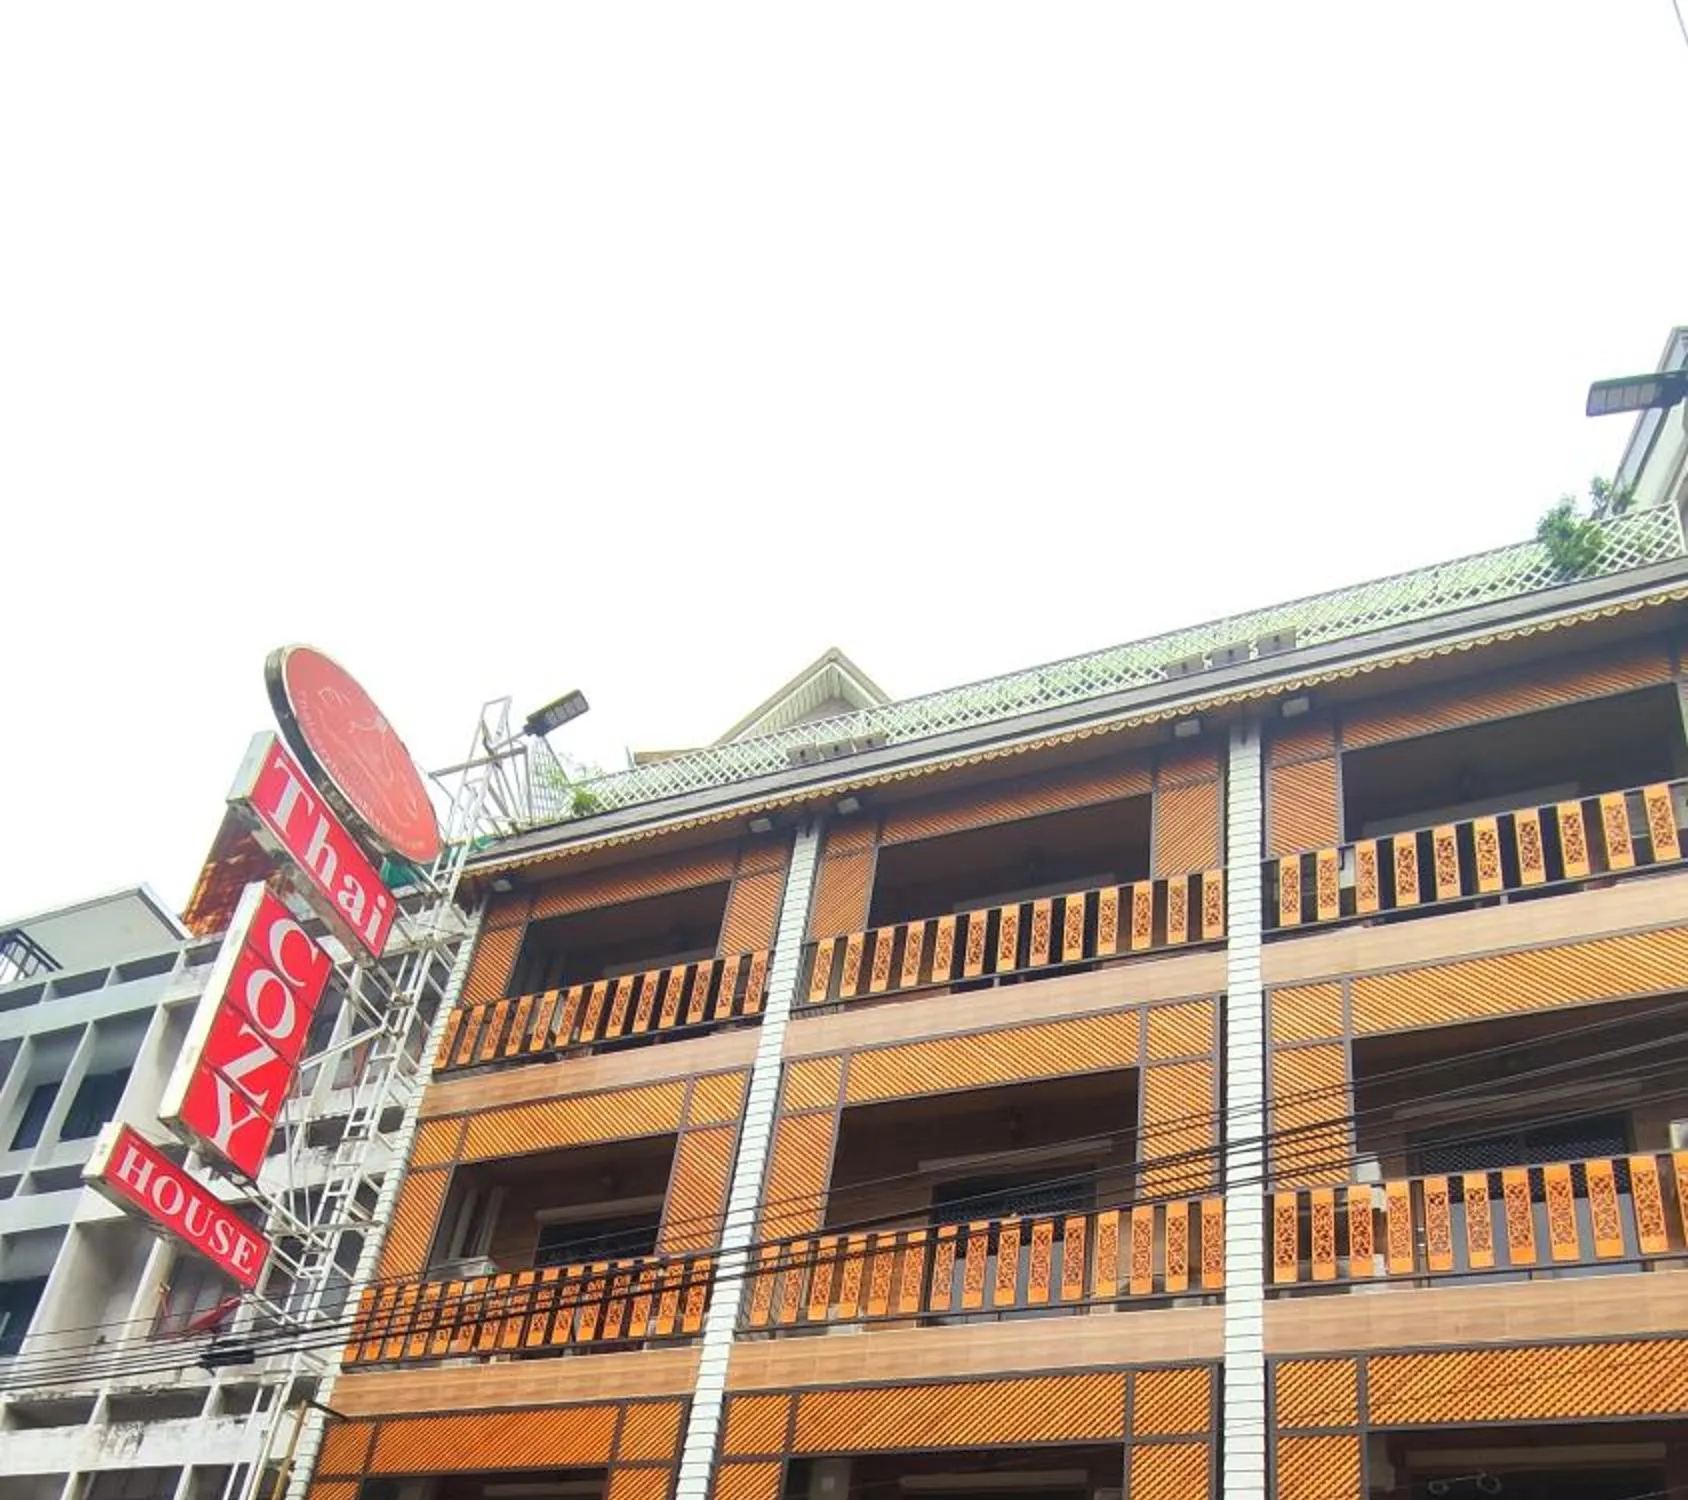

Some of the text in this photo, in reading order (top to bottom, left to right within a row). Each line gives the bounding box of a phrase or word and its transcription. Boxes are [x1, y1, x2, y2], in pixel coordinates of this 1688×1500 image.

[270, 757, 387, 947] Thai
[208, 918, 319, 1151] COZY
[115, 1142, 258, 1276] HOUSE
